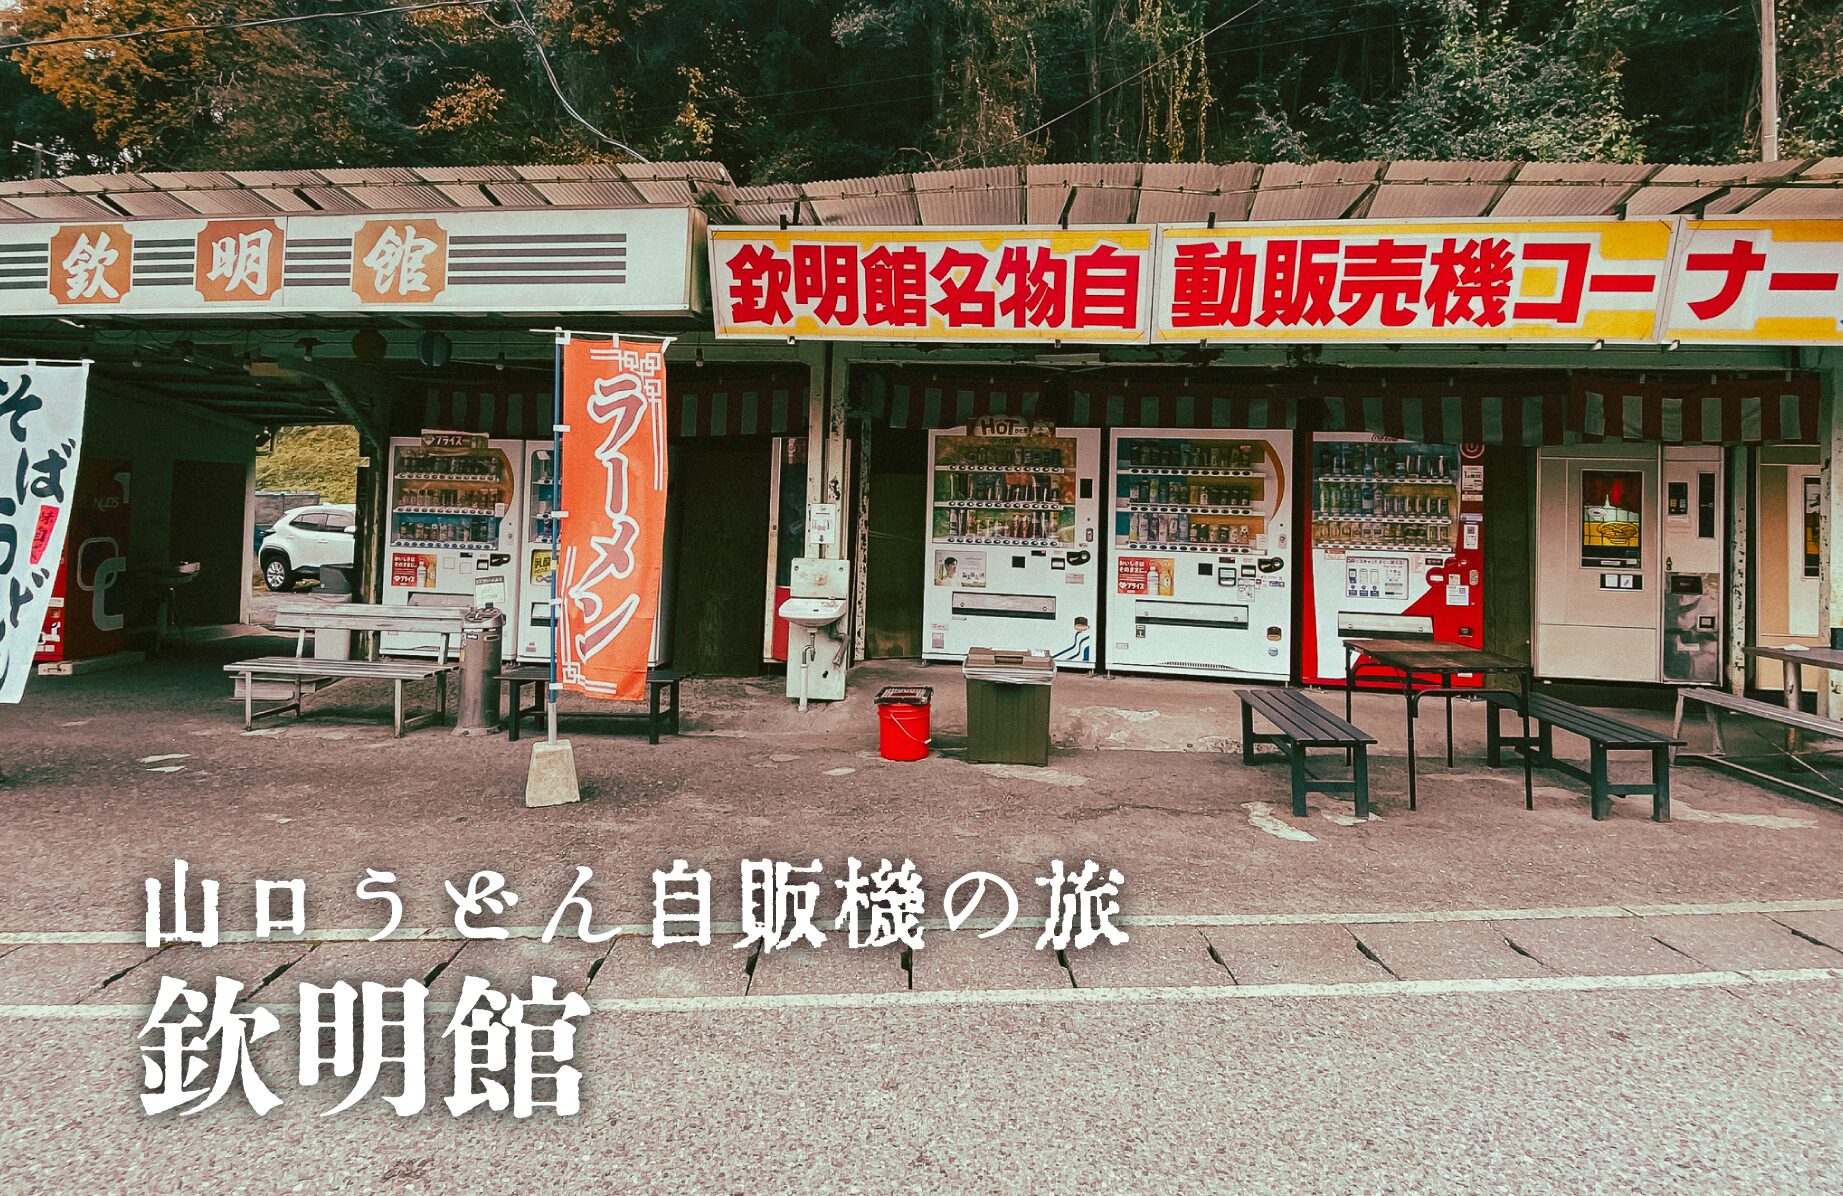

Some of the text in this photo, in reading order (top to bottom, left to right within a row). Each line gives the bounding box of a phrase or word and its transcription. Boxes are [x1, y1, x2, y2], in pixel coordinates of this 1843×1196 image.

[60, 225, 439, 299] 欽明館
[981, 417, 1020, 435] HOT
[569, 373, 648, 664] ラーメン
